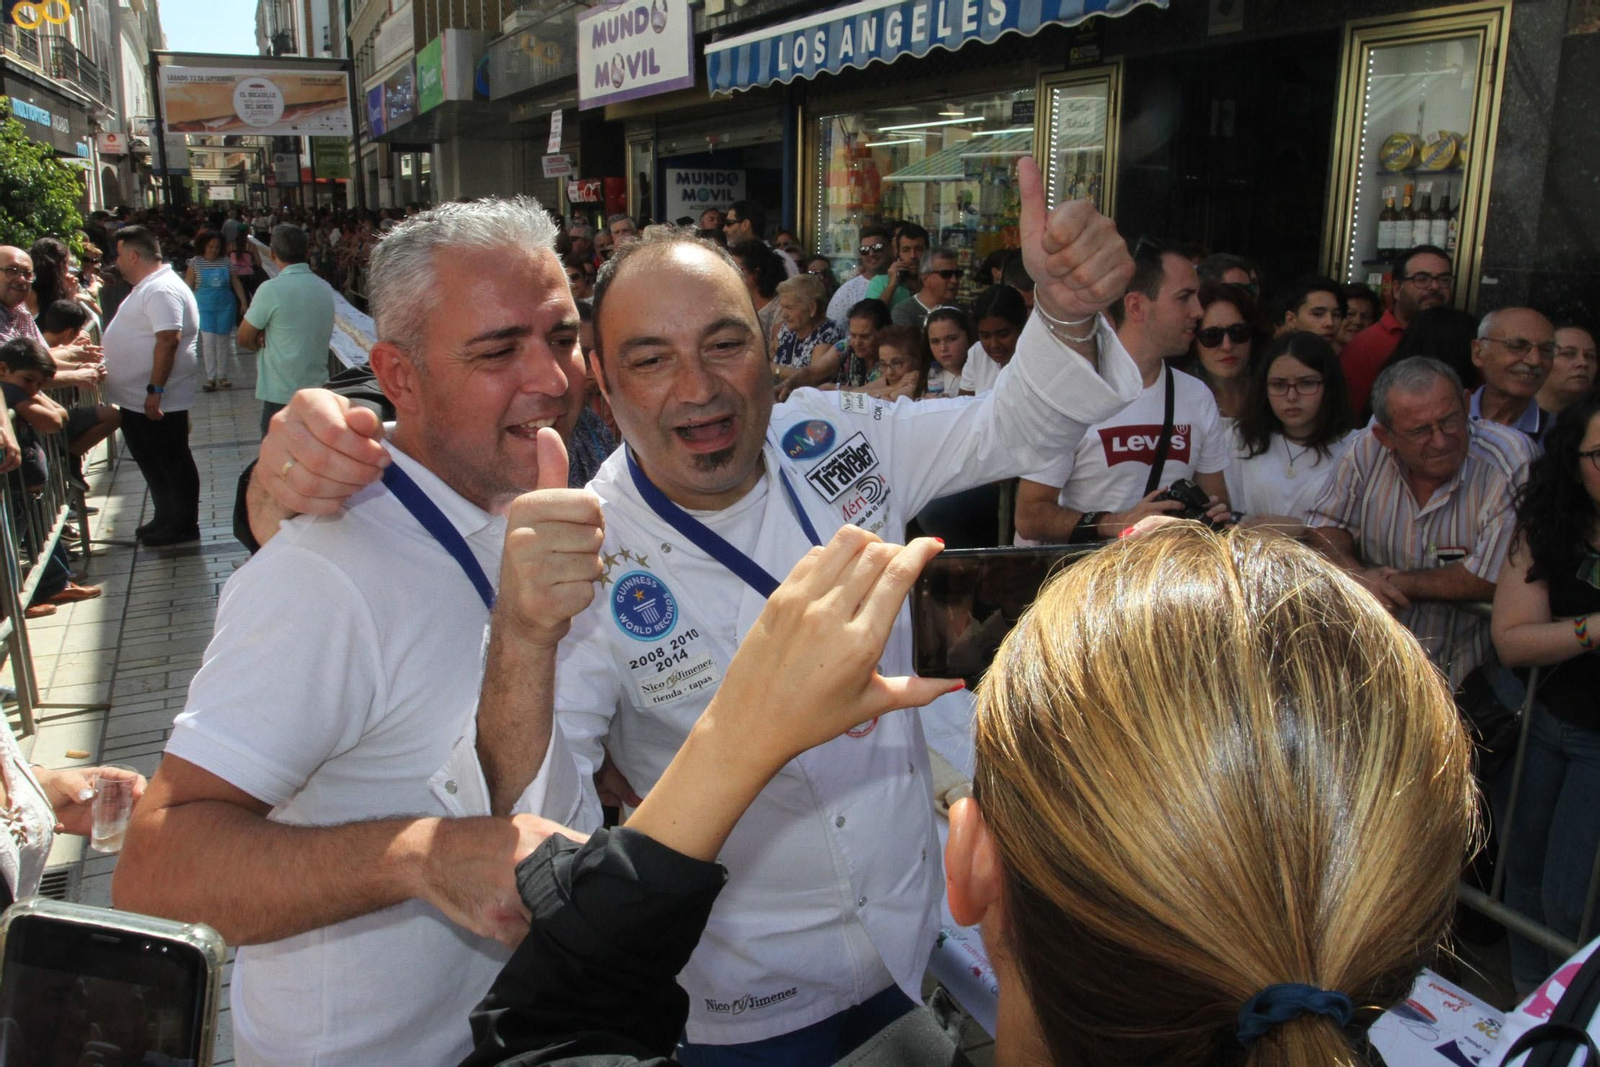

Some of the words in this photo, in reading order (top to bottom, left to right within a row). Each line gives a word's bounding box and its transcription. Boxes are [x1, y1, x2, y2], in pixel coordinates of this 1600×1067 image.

[778, 30, 826, 71] LOS
[839, 0, 1007, 59] ANGELES
[676, 172, 739, 186] MUNDO
[681, 188, 735, 202] MOVIL
[1112, 435, 1186, 452] Levs
[809, 442, 874, 497] Traveler
[616, 576, 658, 603] GUINNESS
[619, 613, 653, 635] WORLD
[654, 592, 675, 632] RECORDS
[629, 647, 665, 670] 2008
[670, 628, 699, 651] 2010
[656, 648, 688, 673] 2014
[641, 680, 665, 694] Nico
[676, 658, 713, 682] Jimenez
[653, 688, 683, 704] tienda
[689, 675, 713, 690] tapas
[705, 998, 730, 1012] Nico
[749, 987, 798, 1009] Jimenez
